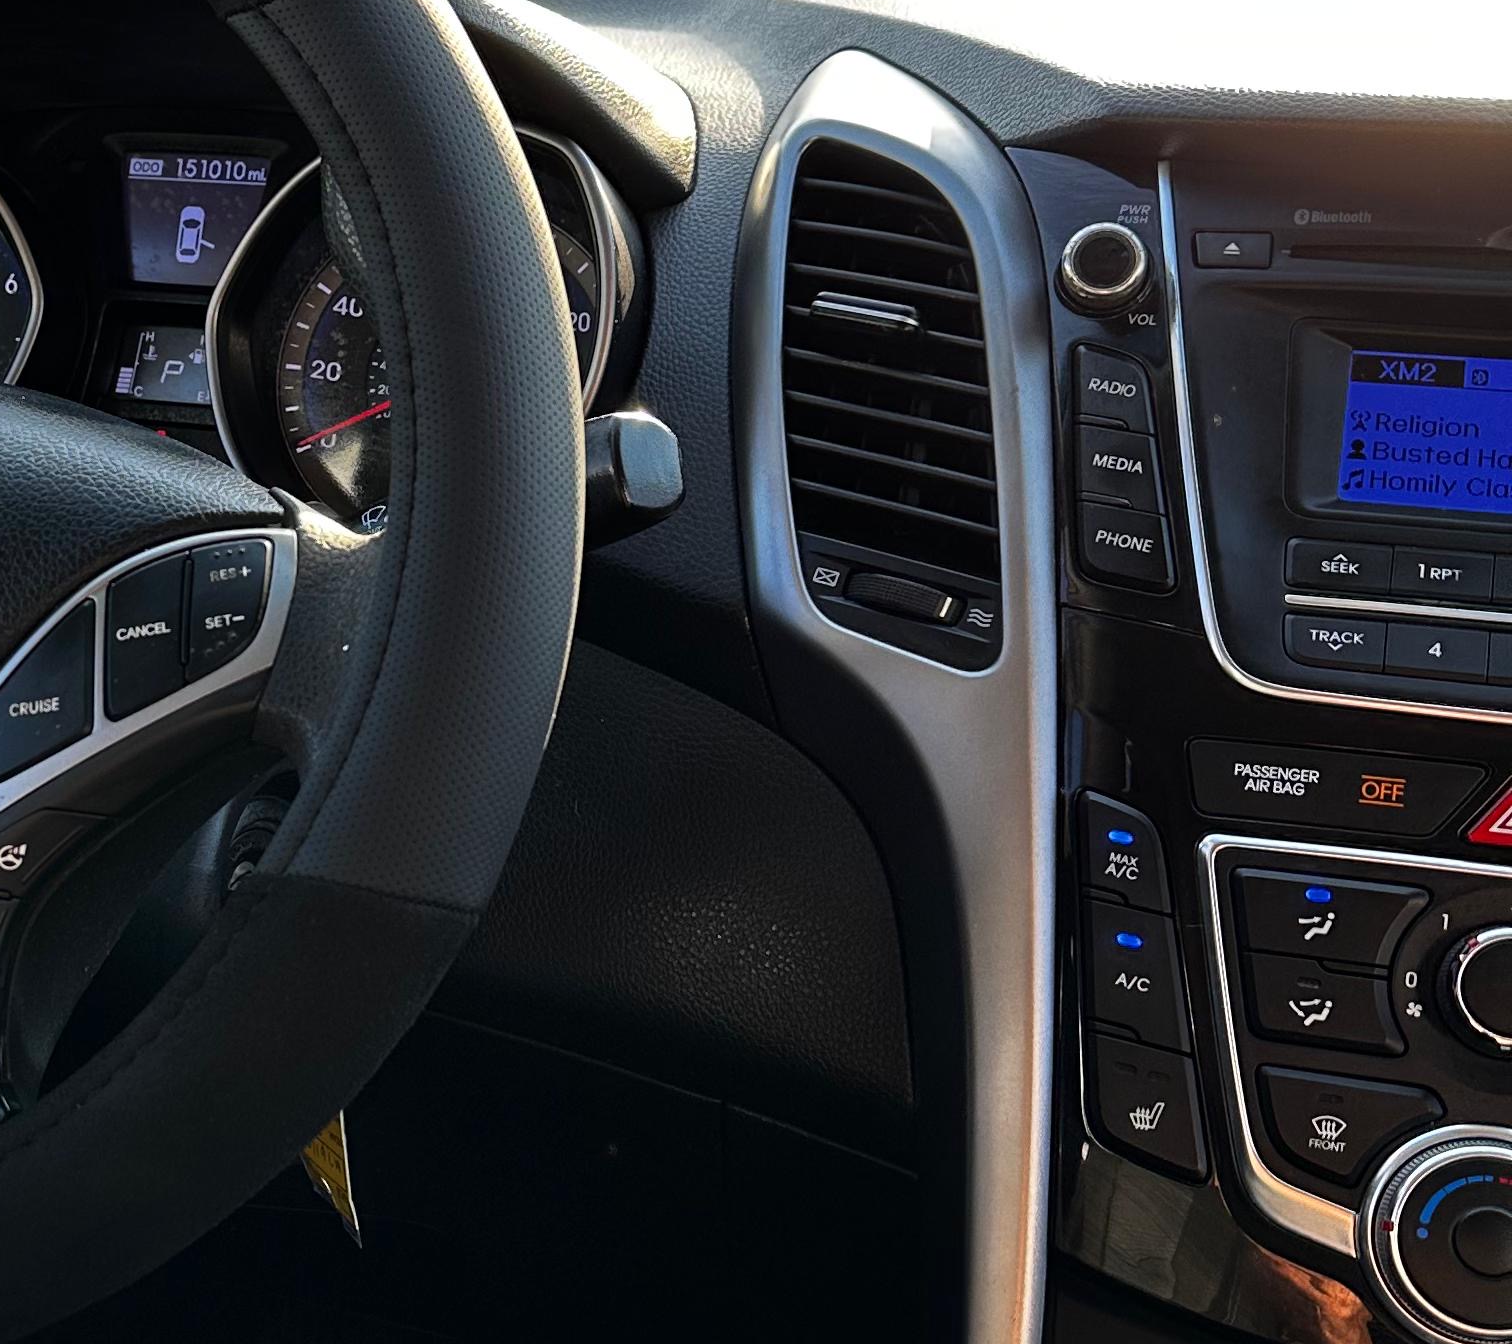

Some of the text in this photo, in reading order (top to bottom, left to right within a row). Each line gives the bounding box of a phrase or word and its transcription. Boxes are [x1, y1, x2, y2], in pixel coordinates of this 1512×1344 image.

[131, 159, 162, 174] ODO
[177, 158, 247, 180] 151010
[1117, 216, 1149, 224] PUSH
[1119, 205, 1151, 216] PWR
[1310, 210, 1372, 224] Bluetooth
[4, 273, 19, 294] 6
[1128, 313, 1157, 326] VOL
[145, 331, 155, 342] H
[160, 360, 185, 384] P
[309, 360, 343, 382] 20
[1378, 359, 1438, 382] XM2
[134, 386, 144, 397] C
[1088, 378, 1137, 398] RADIO
[1375, 412, 1480, 438] Religion
[1372, 441, 1470, 466] Busted
[1092, 453, 1144, 475] MEDIA
[1369, 470, 1457, 496] Homily
[1095, 530, 1154, 554] PHONE
[1320, 560, 1360, 576] SEEK
[1418, 563, 1463, 582] 1 RPT
[116, 621, 172, 642] CANCEL
[1309, 629, 1365, 646] TRACK
[1428, 642, 1443, 658] 4
[8, 697, 61, 718] CRUISE
[1234, 763, 1320, 784] PASSENGER
[1244, 778, 1305, 796] AIR BAG
[1361, 781, 1405, 802] OFF
[1109, 852, 1139, 868] MAX
[1104, 862, 1140, 881] A/C
[1442, 913, 1449, 930] 1
[1114, 972, 1151, 993] A/C
[1405, 971, 1418, 988] 0
[1308, 1137, 1347, 1153] FRONT
